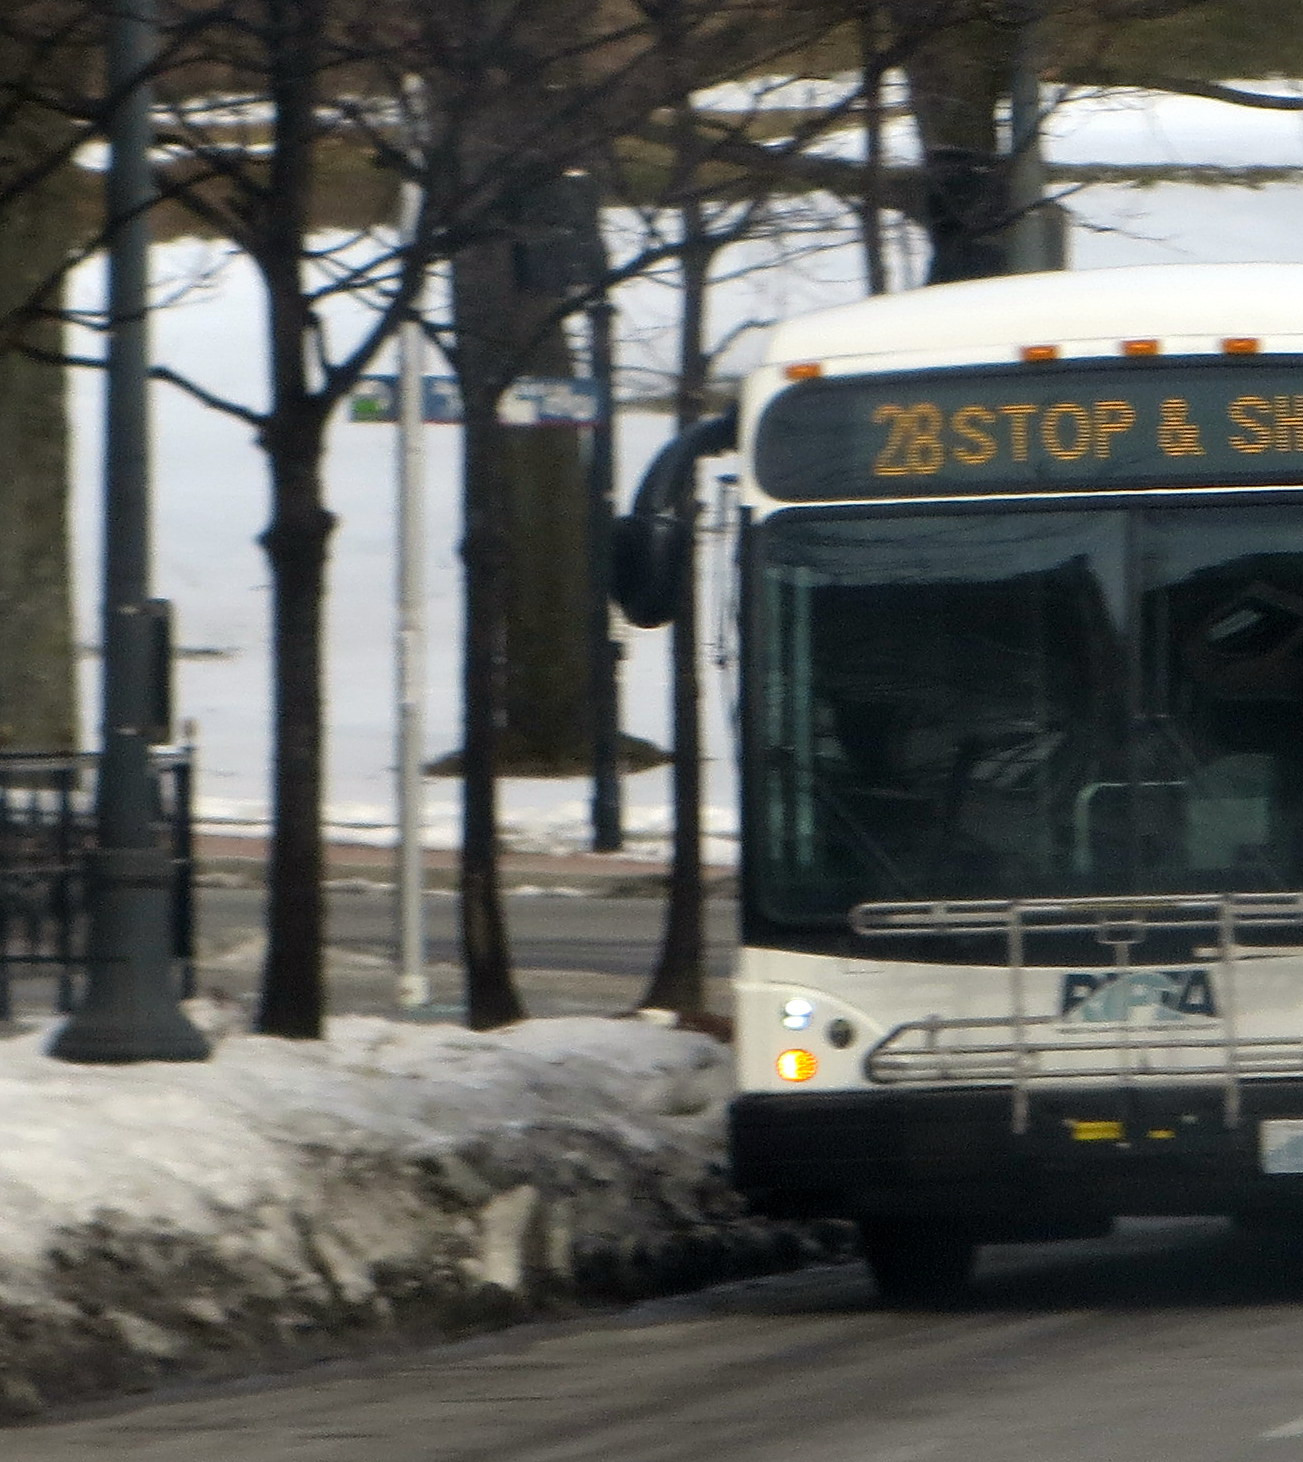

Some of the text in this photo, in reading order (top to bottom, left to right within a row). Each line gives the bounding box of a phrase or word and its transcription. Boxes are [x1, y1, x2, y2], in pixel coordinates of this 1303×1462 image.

[872, 402, 944, 476] 28
[953, 400, 1136, 464] STOP
[1157, 397, 1206, 456] &
